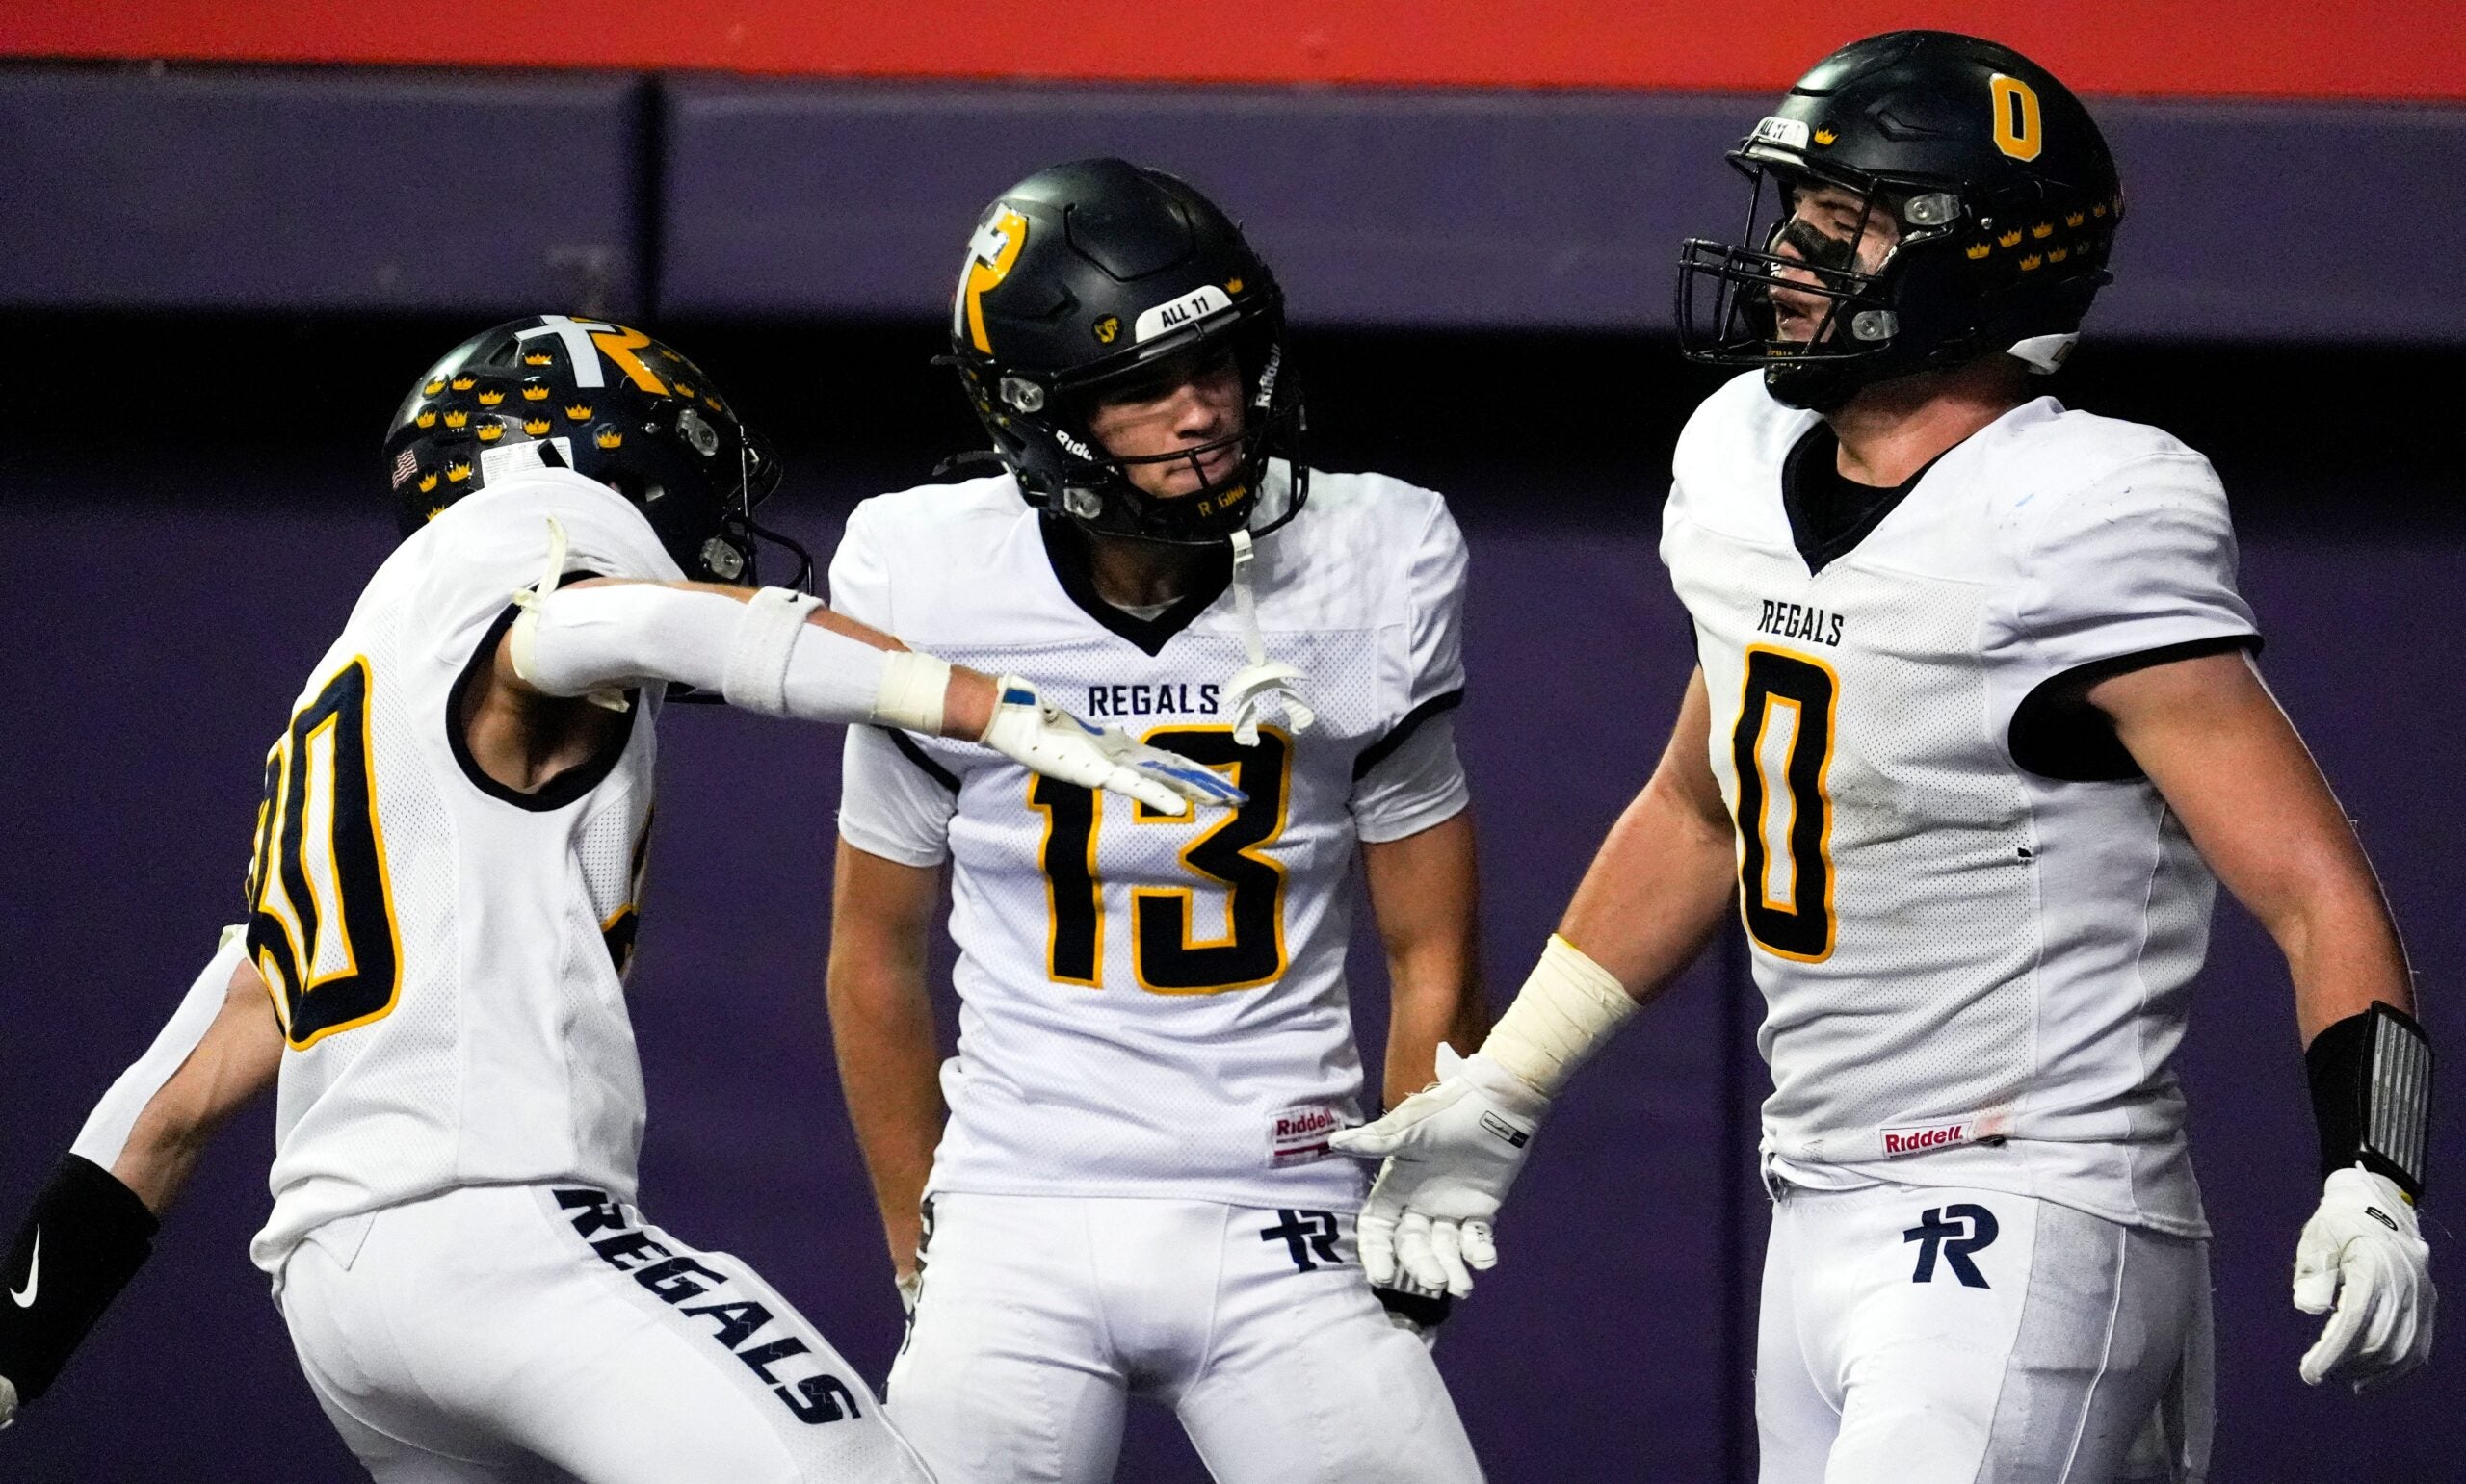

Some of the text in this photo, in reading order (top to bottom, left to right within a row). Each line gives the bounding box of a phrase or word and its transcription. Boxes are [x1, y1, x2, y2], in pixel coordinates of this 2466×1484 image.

[1989, 72, 2042, 163] 0
[1160, 295, 1211, 328] ALL 11
[1756, 599, 1844, 647] REGALS
[1089, 683, 1220, 716] REGALS
[1731, 641, 1841, 965] 0
[1026, 723, 1292, 997] 13
[1276, 1107, 1336, 1136] Riddell
[1884, 1125, 1962, 1154] Riddell
[552, 1188, 862, 1426] REGALS
